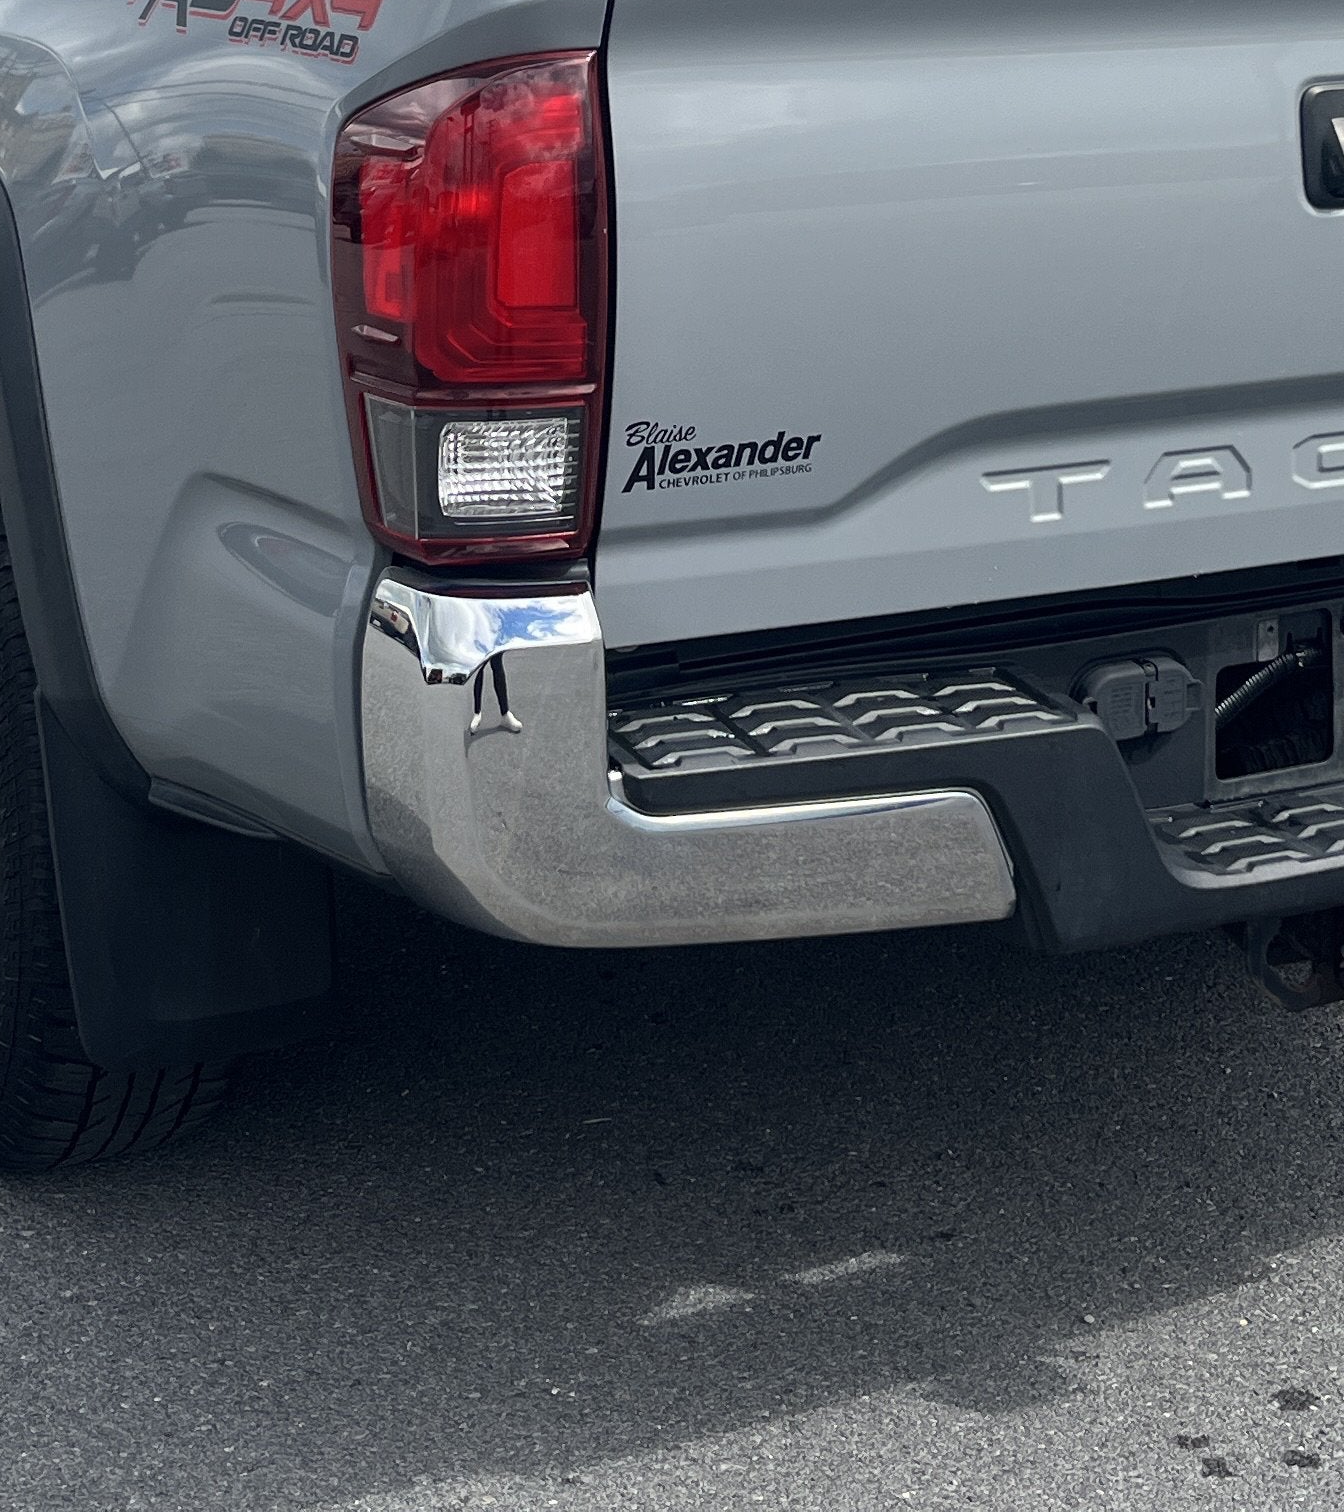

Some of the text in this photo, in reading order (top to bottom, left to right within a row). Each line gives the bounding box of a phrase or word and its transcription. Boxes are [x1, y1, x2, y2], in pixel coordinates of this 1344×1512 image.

[228, 15, 360, 65] OFF ROAD
[625, 421, 697, 447] Blaise
[621, 431, 822, 493] Alexander
[658, 472, 731, 489] CHEVROLET
[732, 471, 747, 481] OF
